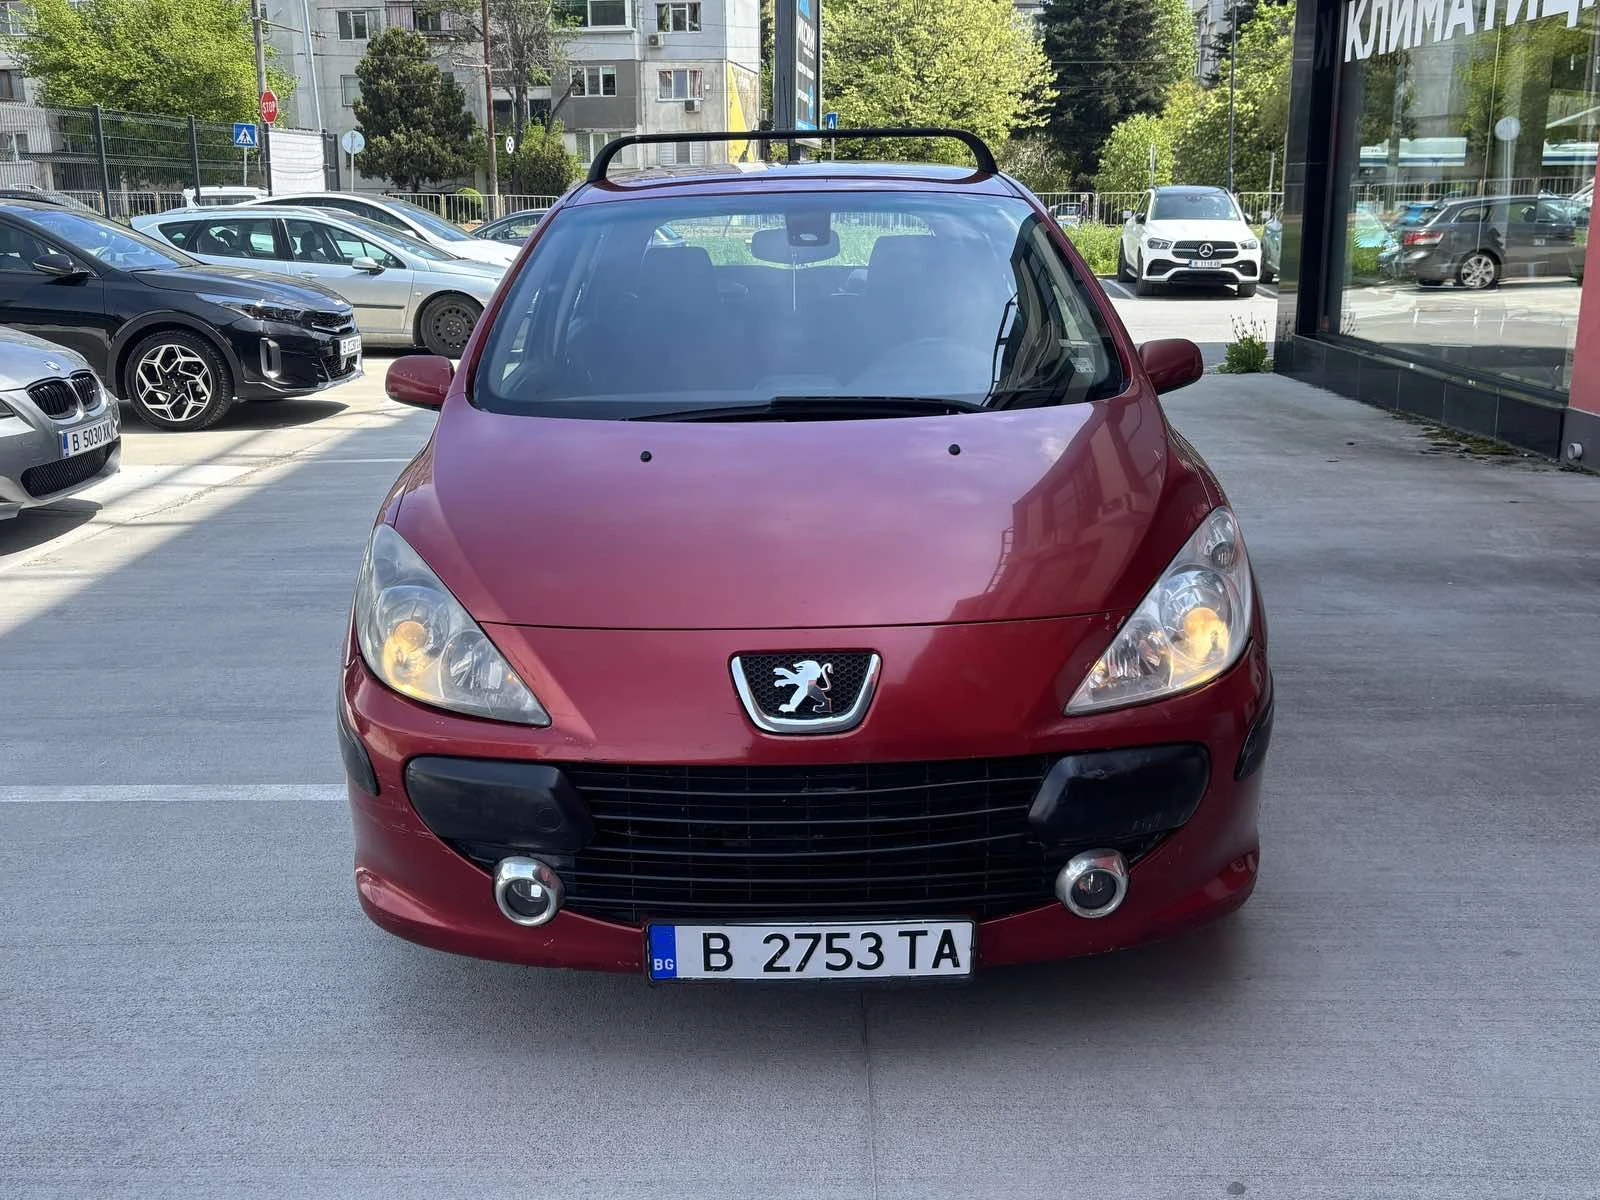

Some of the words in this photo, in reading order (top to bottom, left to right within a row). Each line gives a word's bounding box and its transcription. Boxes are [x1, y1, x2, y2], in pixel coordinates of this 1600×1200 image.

[1344, 0, 1598, 63] КЛИМА
[262, 101, 276, 113] STOP
[73, 433, 80, 451] B
[83, 426, 102, 448] 5030
[702, 932, 733, 972] B
[762, 931, 885, 973] 2753
[898, 929, 961, 970] TA
[653, 958, 675, 971] BG
